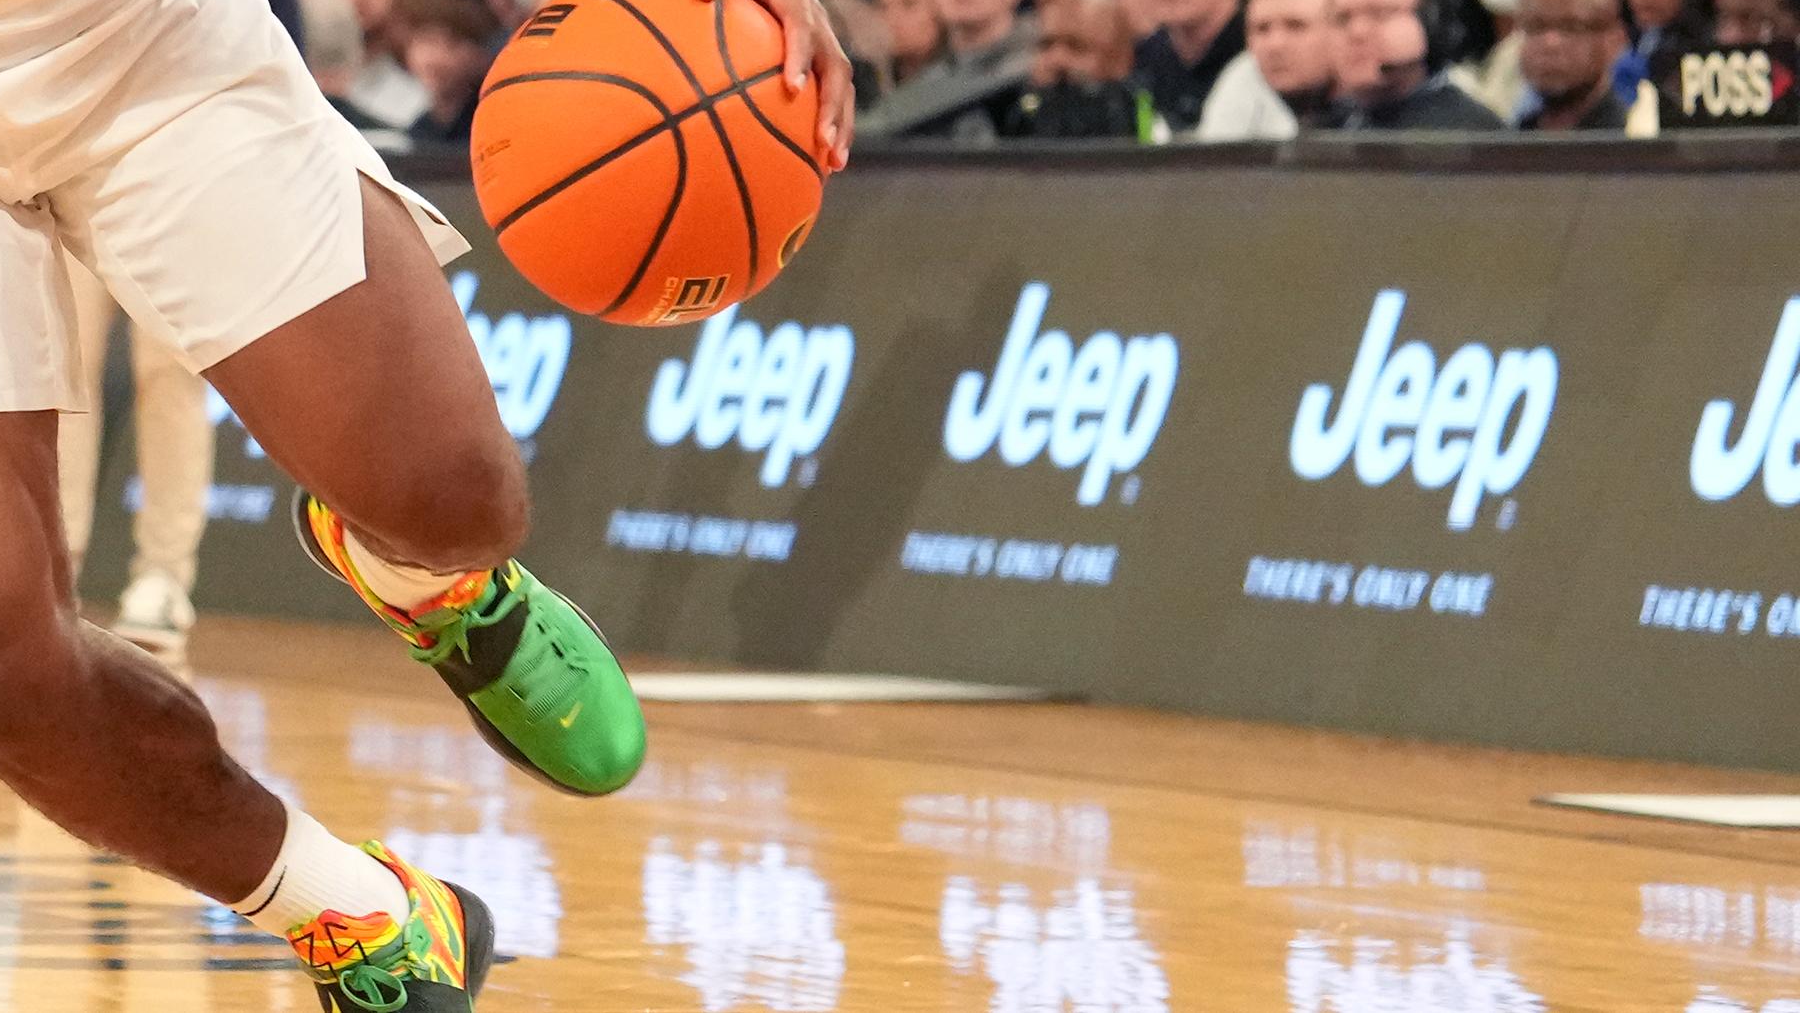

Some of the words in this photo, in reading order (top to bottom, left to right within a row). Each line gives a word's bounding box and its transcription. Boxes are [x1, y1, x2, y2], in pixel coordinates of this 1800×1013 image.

[1680, 49, 1773, 118] POSS
[644, 301, 856, 489] Jeep
[944, 282, 1179, 506] Jeep
[1289, 288, 1560, 530] Jeep
[1639, 584, 1763, 636] THERE'S
